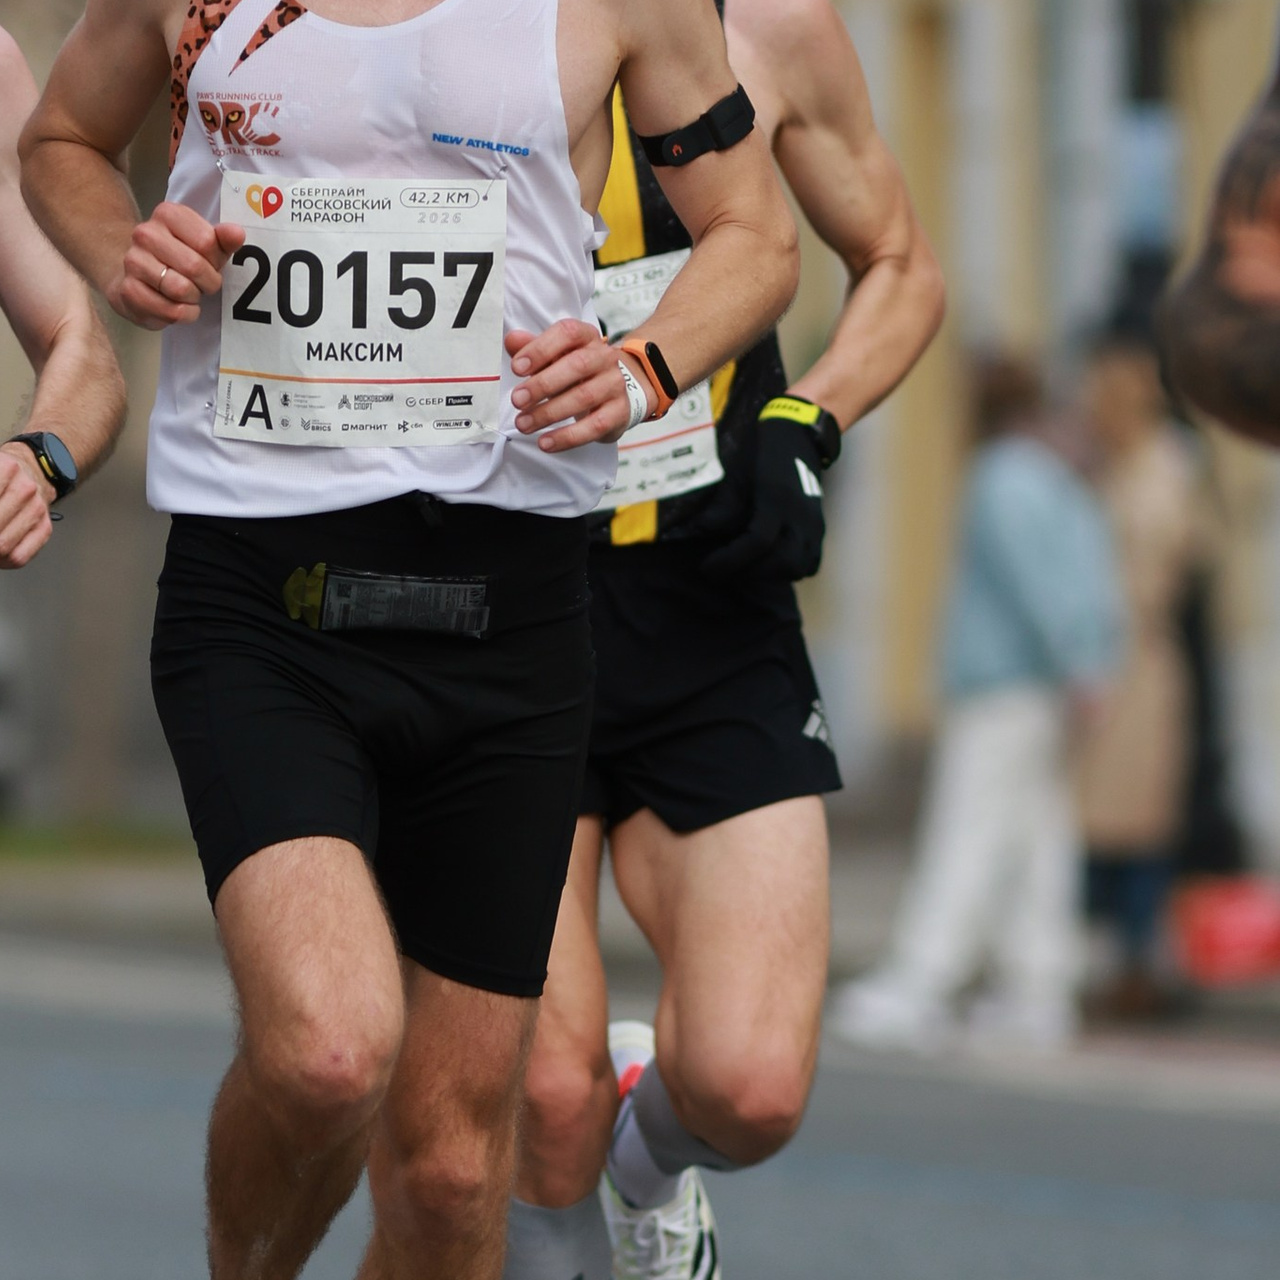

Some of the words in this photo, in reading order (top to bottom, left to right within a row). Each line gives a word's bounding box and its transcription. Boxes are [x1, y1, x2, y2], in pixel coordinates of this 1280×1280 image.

[215, 92, 257, 101] RUNNING
[258, 92, 283, 101] CLUB
[432, 133, 464, 145] NEW
[465, 138, 530, 157] ATHLETICS
[291, 186, 366, 197] СБЕРПРАЙМ
[290, 198, 392, 210] МОСКОВСКИЙ
[408, 191, 441, 205] 42,2
[290, 211, 365, 223] МАРАФОН
[417, 211, 462, 224] 2026
[231, 244, 495, 330] 20157
[306, 341, 403, 362] МАКСИМ
[354, 393, 394, 402] МОСКОВСКИЙ
[418, 398, 444, 406] СБЕР
[238, 383, 274, 430] A
[354, 402, 373, 410] СПОРТ
[350, 423, 388, 431] магнит
